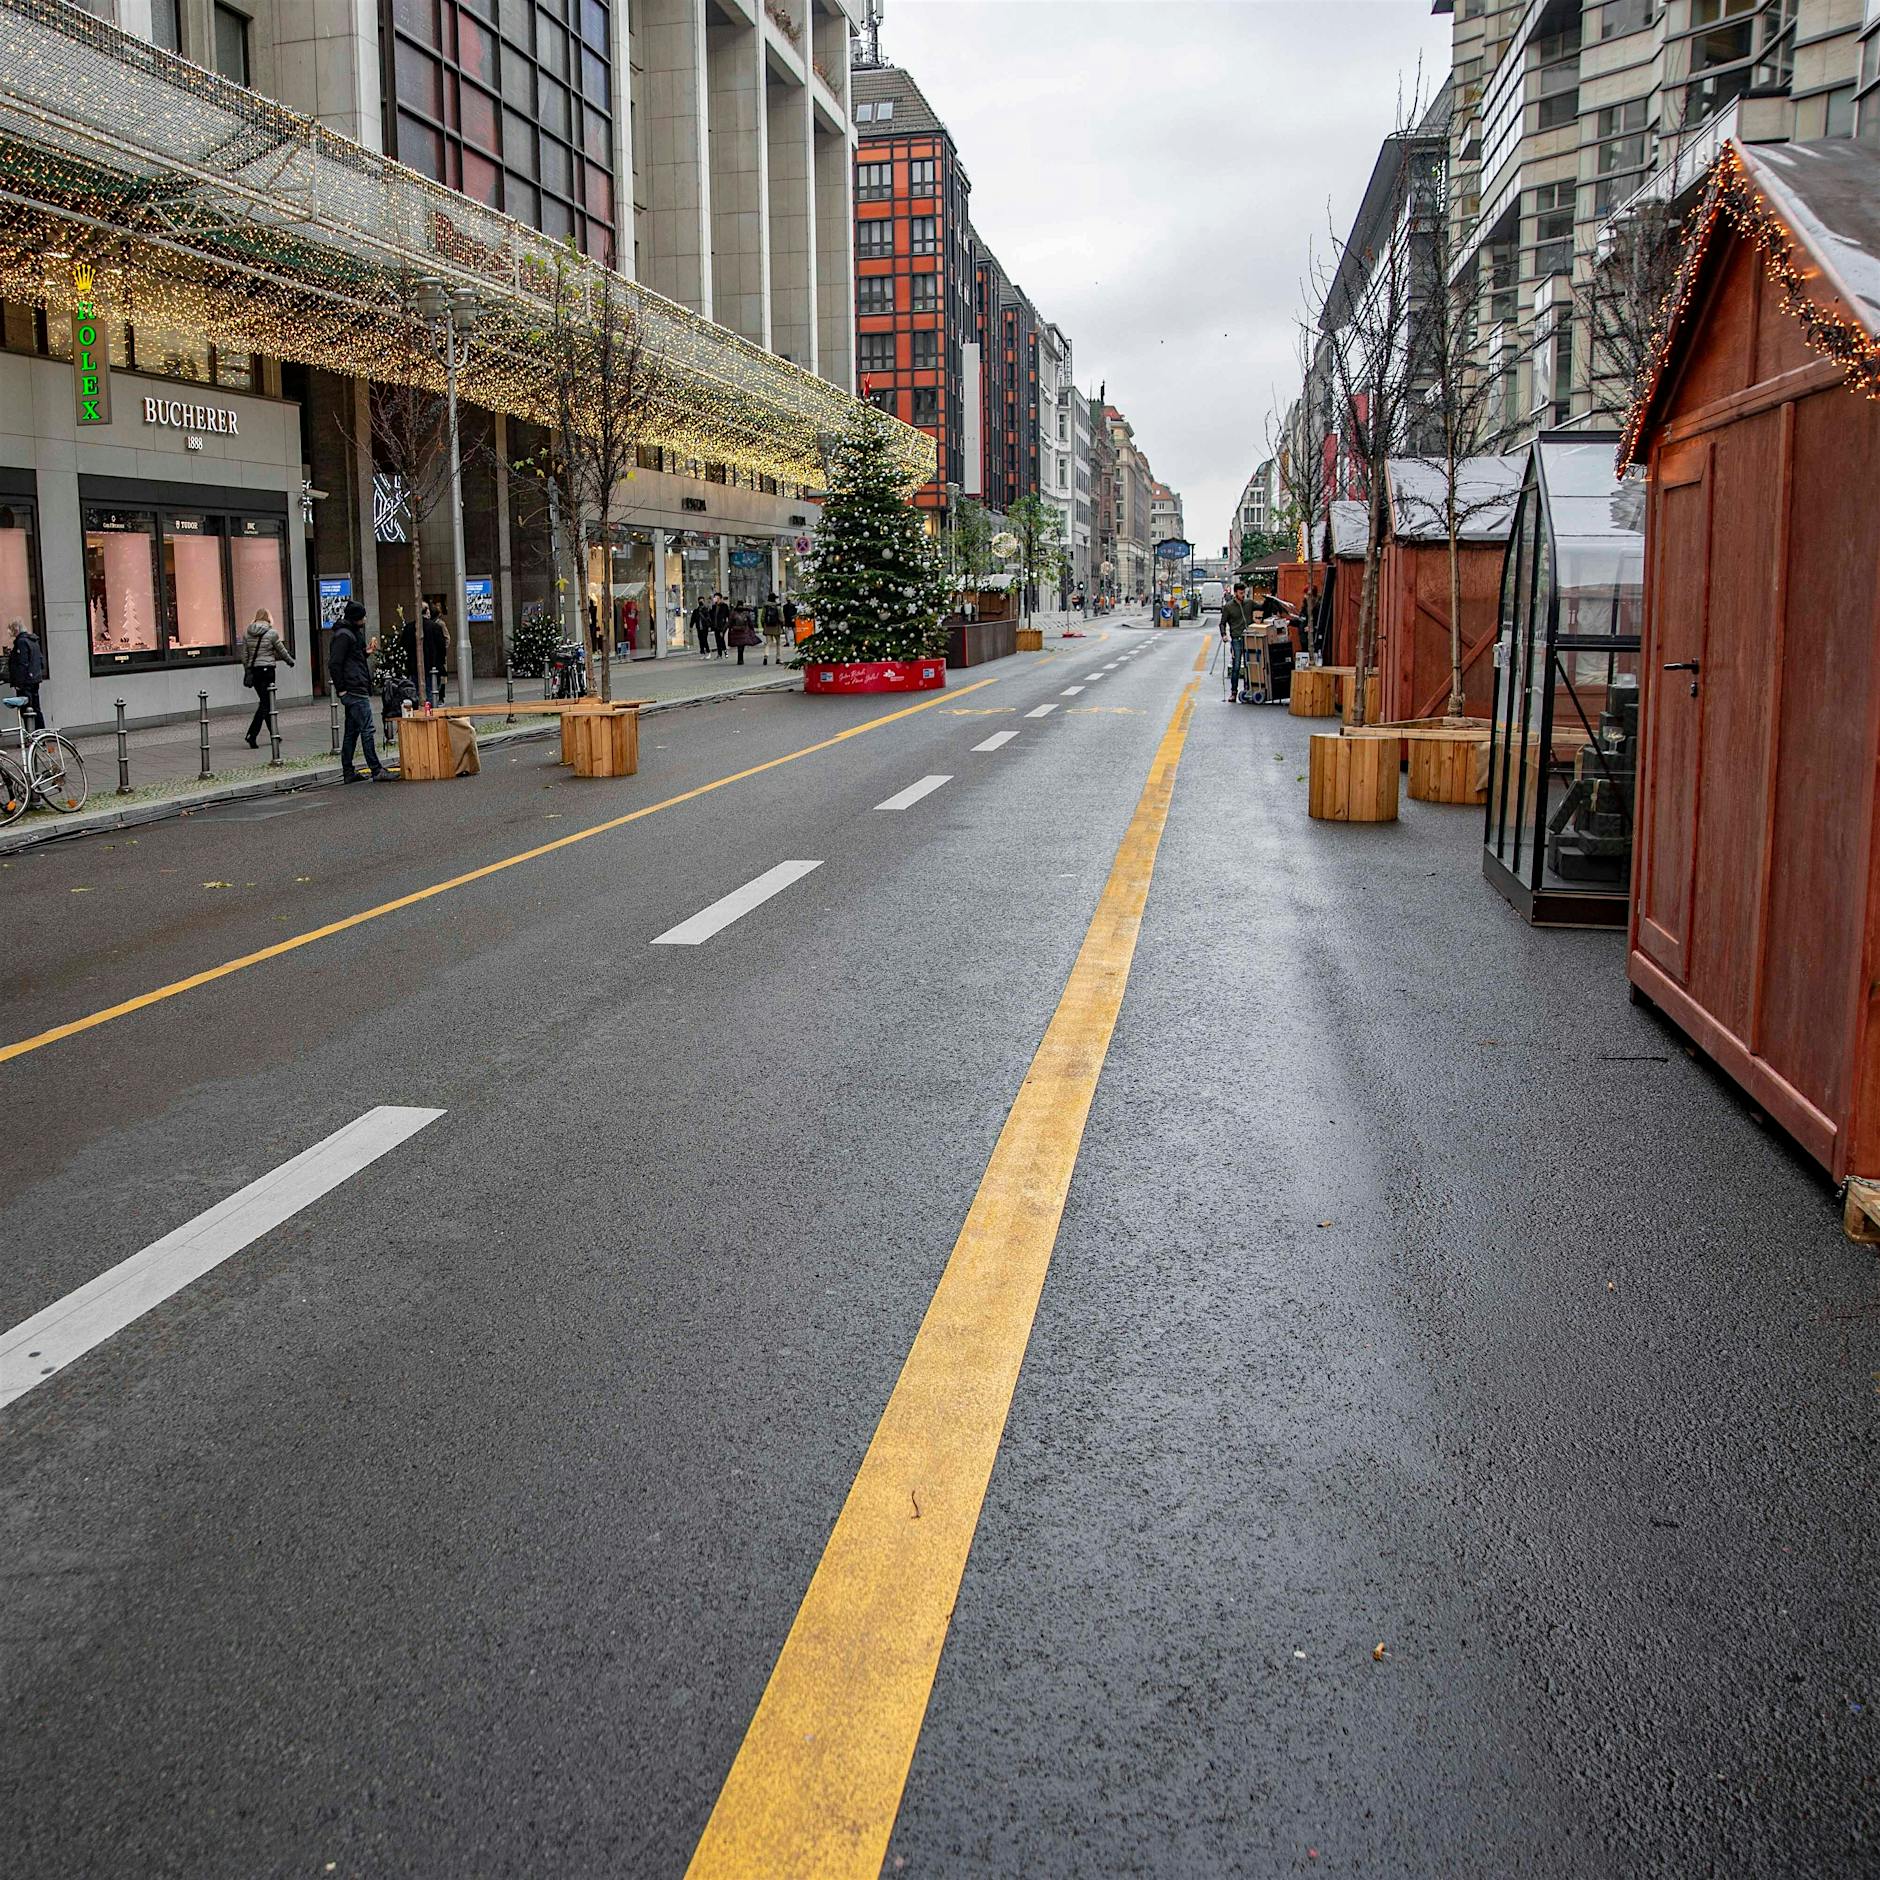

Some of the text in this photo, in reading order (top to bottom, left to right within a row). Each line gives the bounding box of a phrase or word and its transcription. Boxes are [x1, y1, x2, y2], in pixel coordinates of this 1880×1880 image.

[77, 301, 101, 421] ROLEX
[144, 397, 239, 435] BUCHERER
[187, 436, 203, 450] 1888
[181, 521, 198, 530] TUDOR
